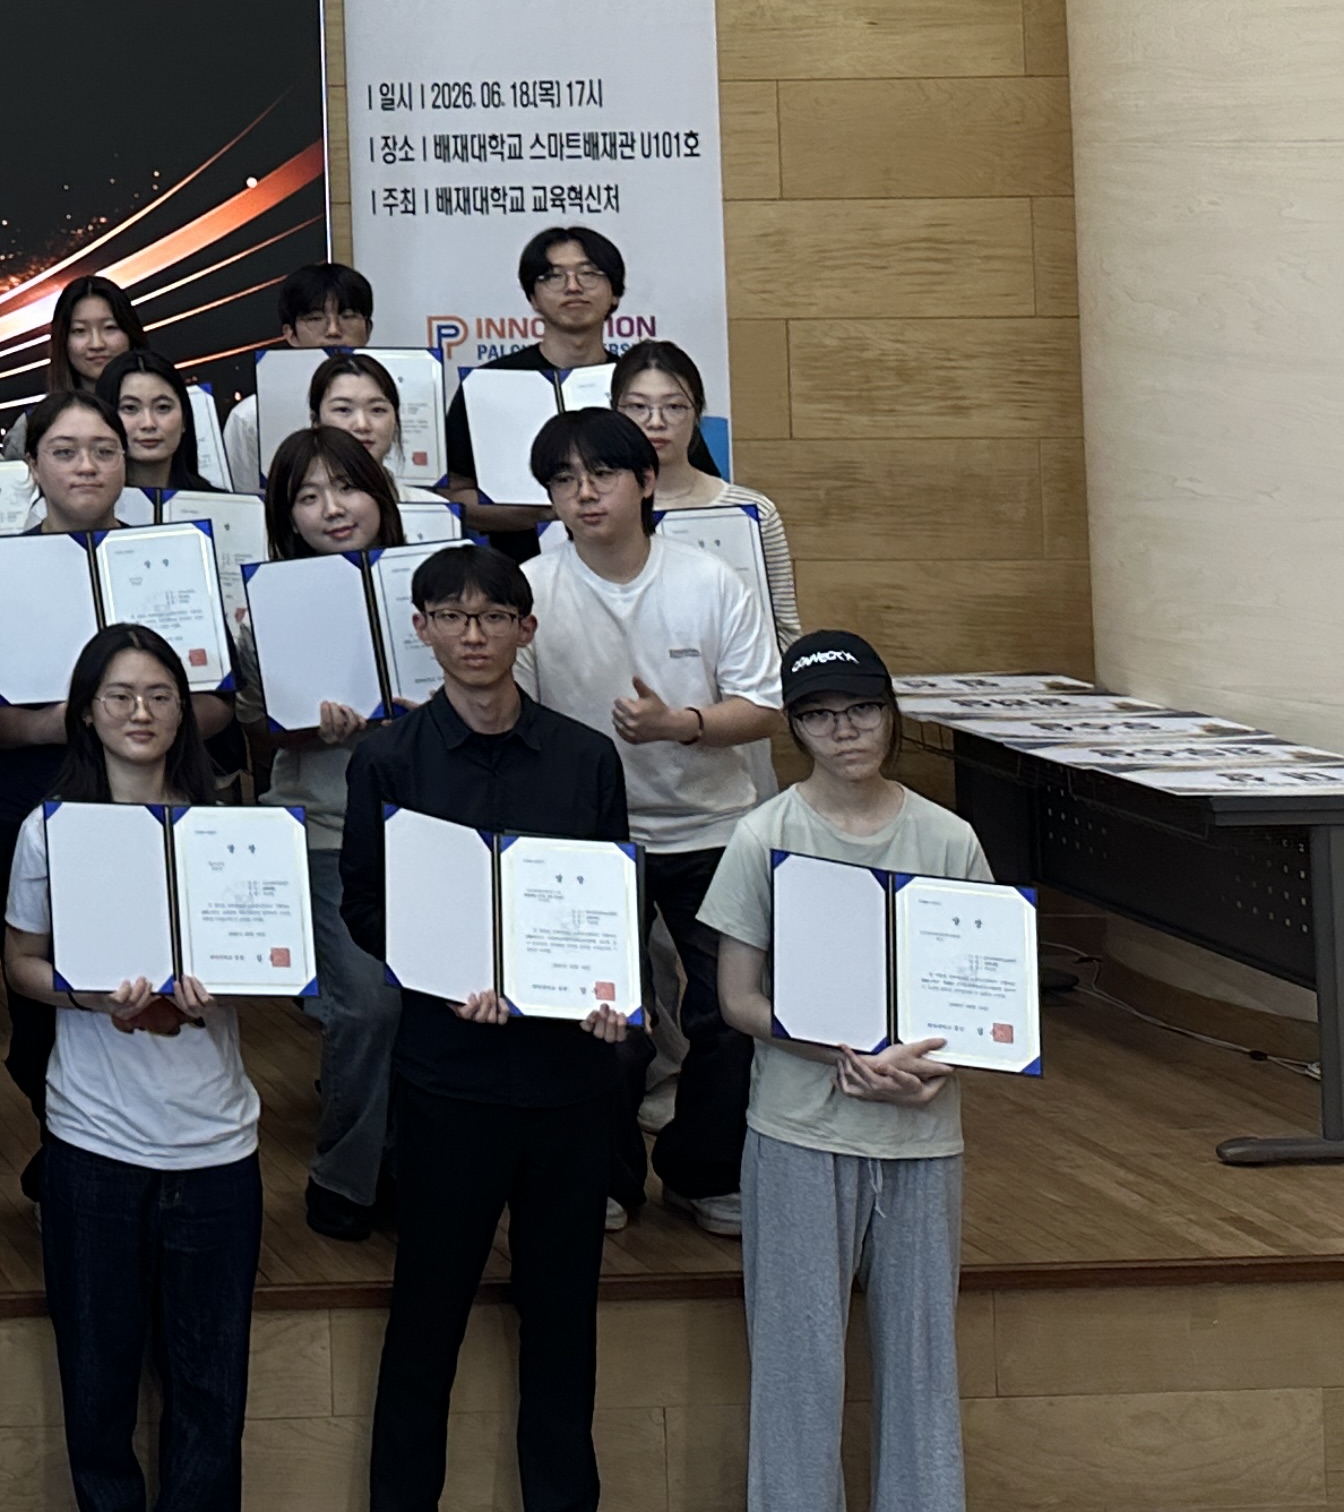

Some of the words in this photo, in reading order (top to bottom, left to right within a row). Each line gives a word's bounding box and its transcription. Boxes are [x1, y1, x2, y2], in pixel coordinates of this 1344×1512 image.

[379, 82, 413, 112] 일시
[431, 81, 477, 109] 2026.
[480, 81, 506, 109] 06.
[566, 78, 603, 108] 17시
[381, 135, 415, 165] 장소
[433, 133, 524, 163] 배재대학교
[529, 131, 637, 162] 스마트배재관
[640, 129, 701, 159] U101호
[383, 187, 417, 217] 주최
[435, 185, 526, 216] 배재대학교
[531, 183, 620, 214] 교육혁신처
[475, 315, 656, 339] INNOION
